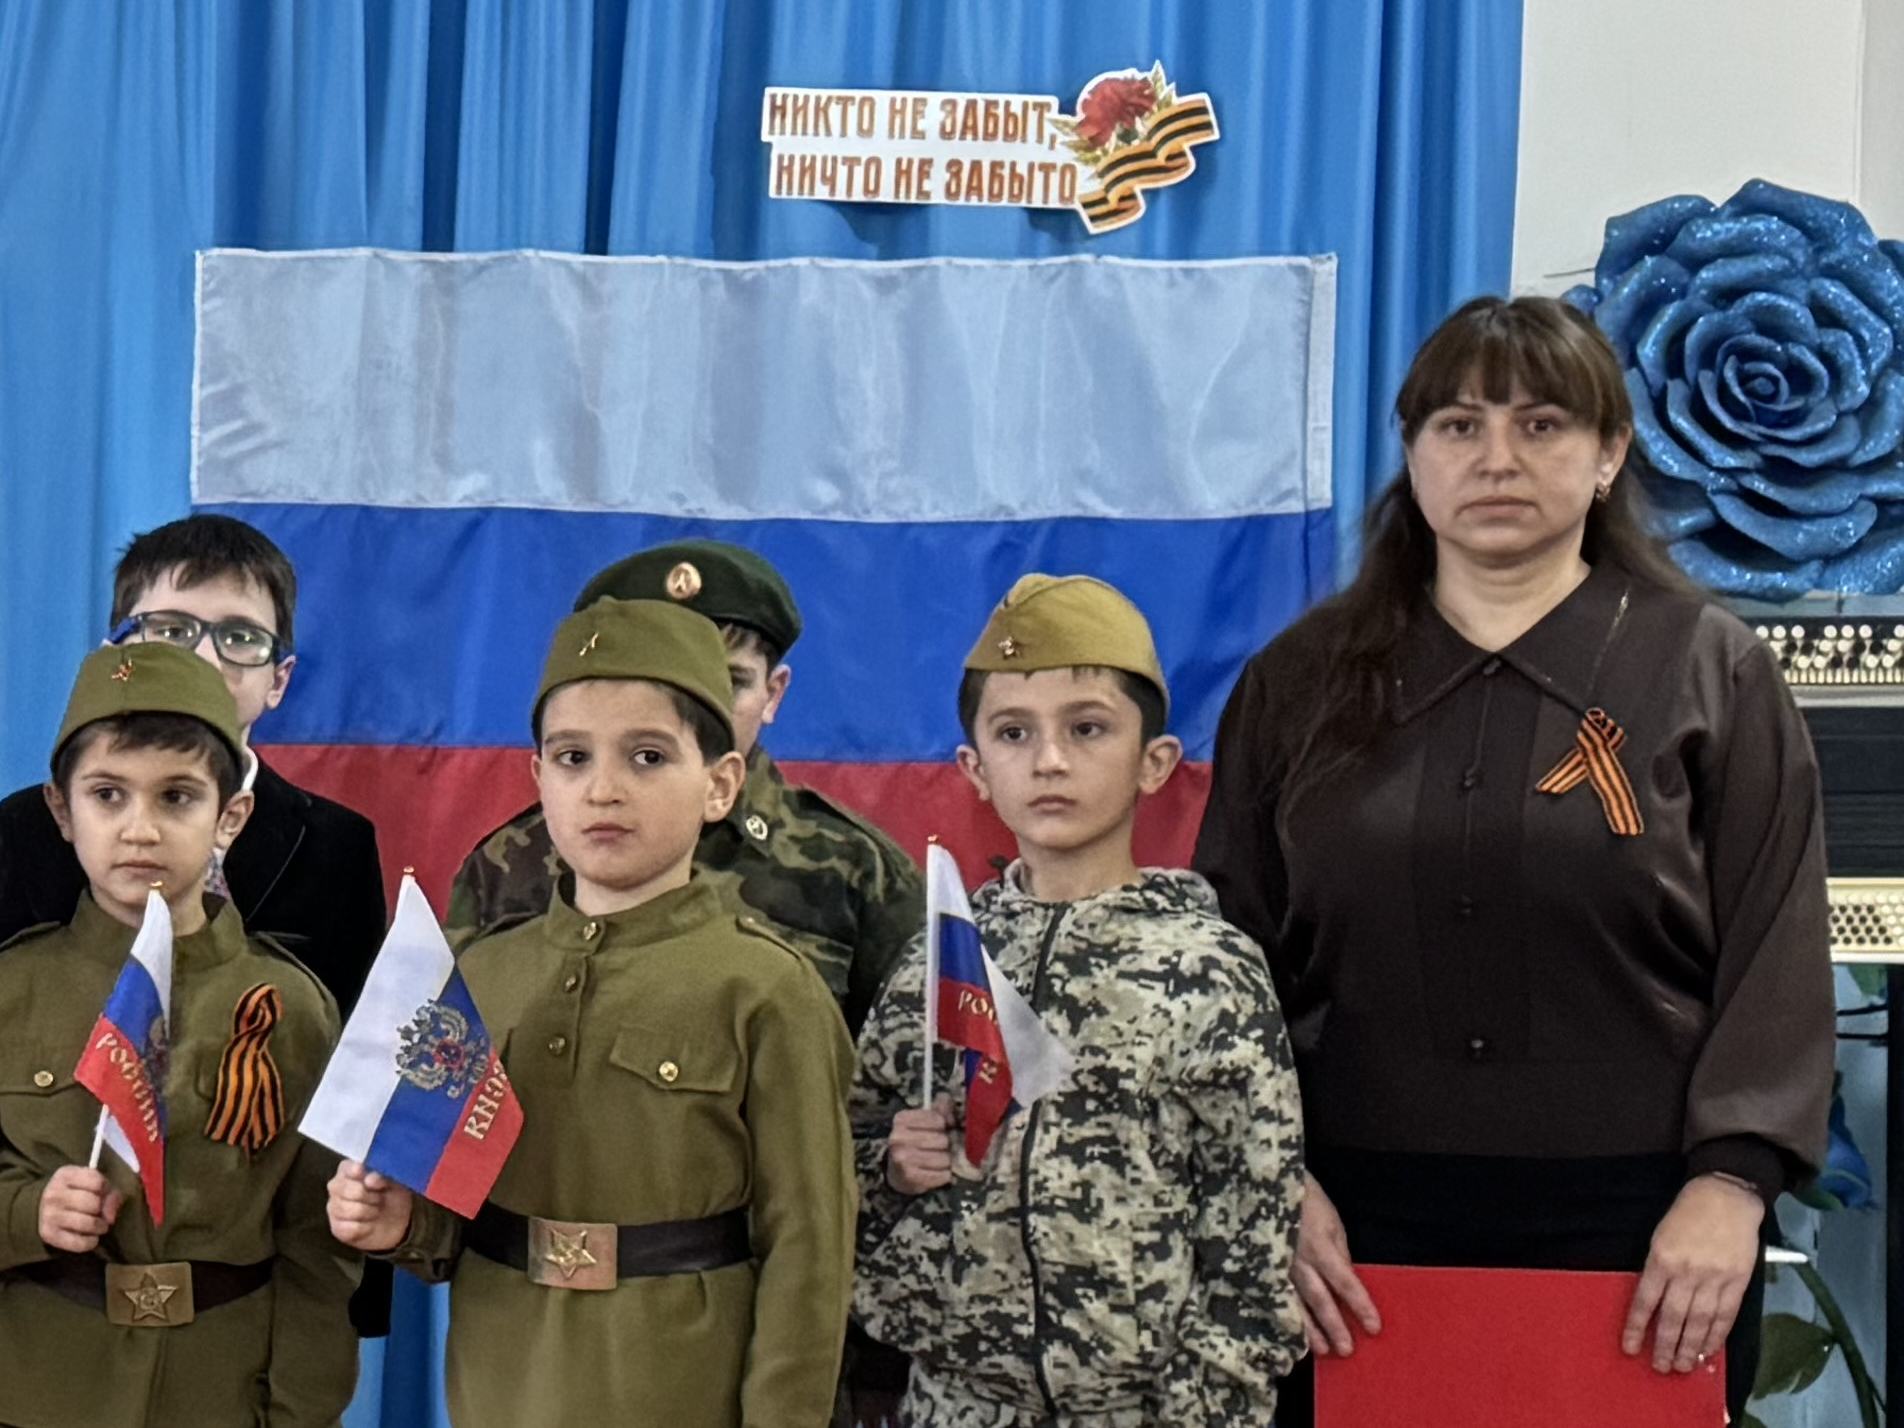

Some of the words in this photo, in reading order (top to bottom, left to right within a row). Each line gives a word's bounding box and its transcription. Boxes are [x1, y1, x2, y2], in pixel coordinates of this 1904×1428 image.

[768, 93, 875, 139] НИКТО
[888, 96, 926, 140] НЕ
[939, 98, 1057, 151] ЗАБЫТ,
[775, 153, 881, 199] НИЧТО
[894, 156, 933, 201] НЕ
[944, 158, 1078, 205] ЗАБЫТО
